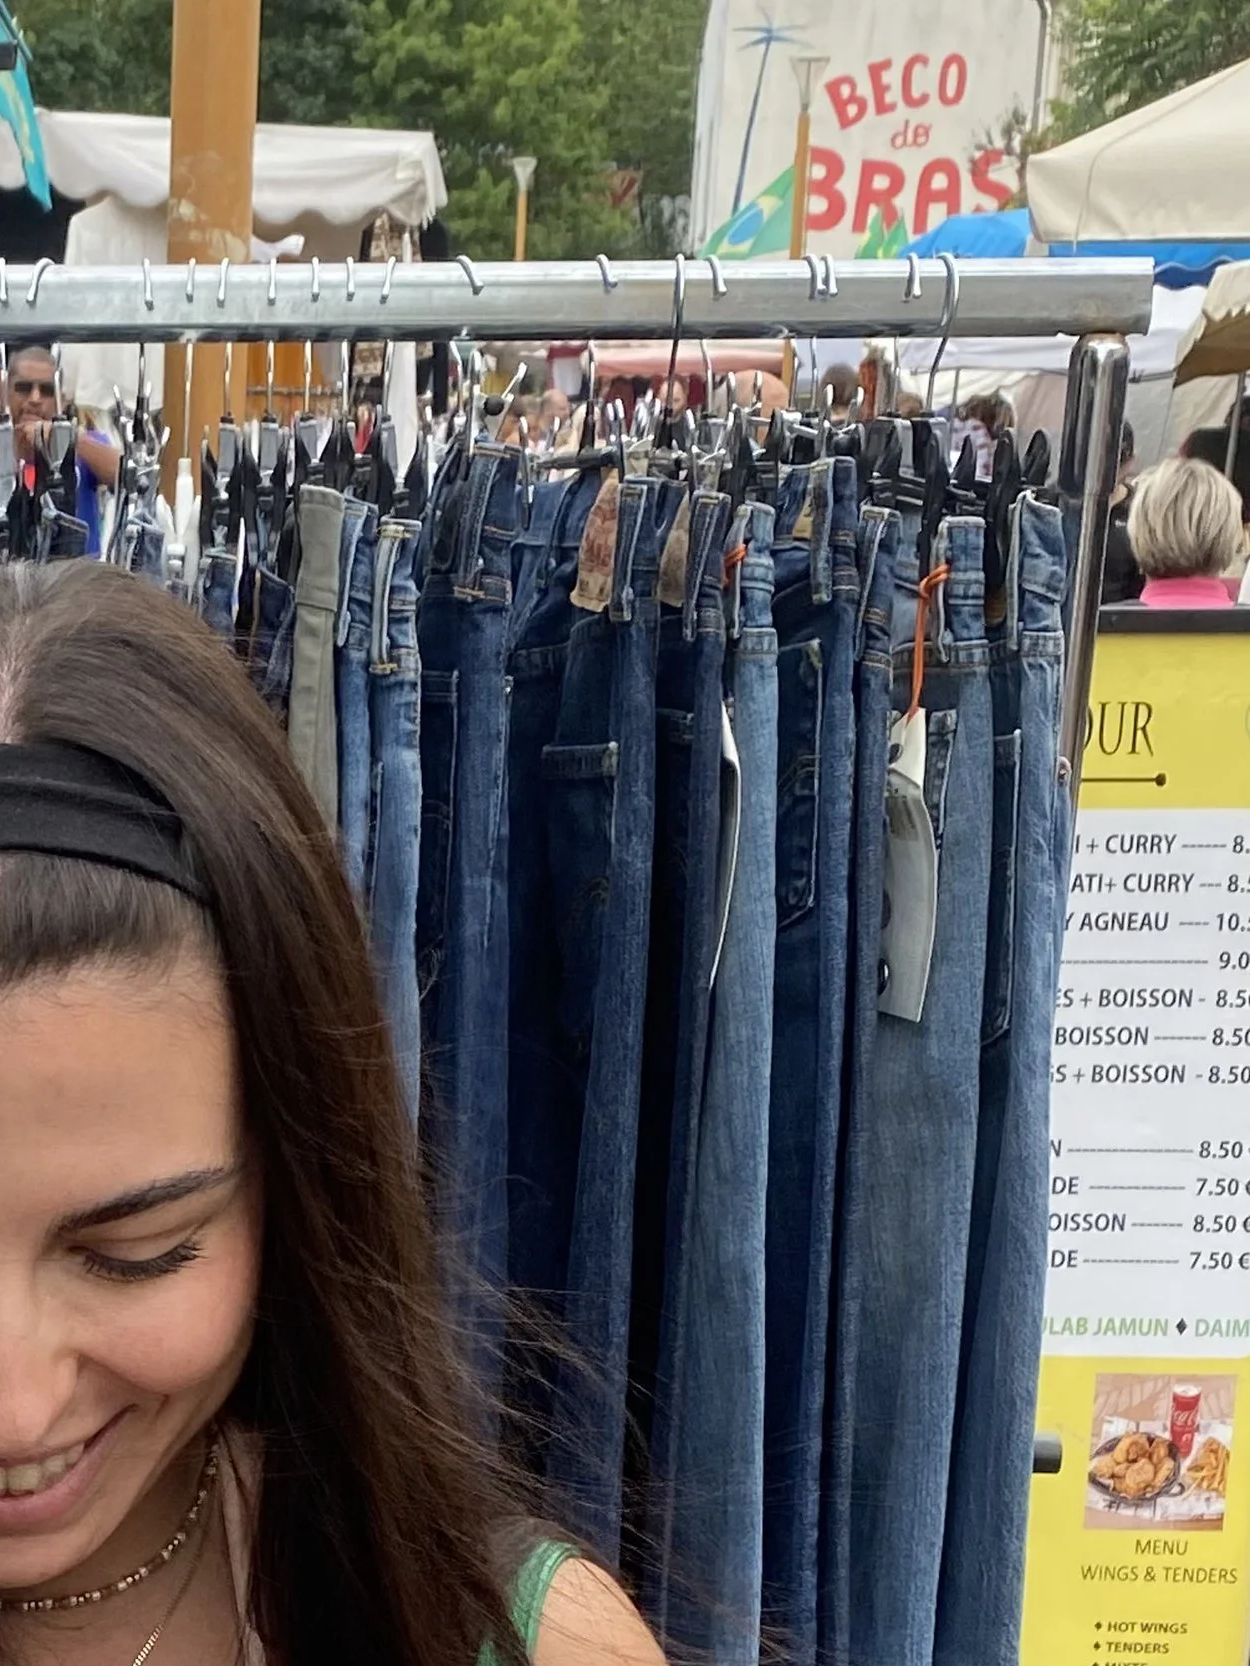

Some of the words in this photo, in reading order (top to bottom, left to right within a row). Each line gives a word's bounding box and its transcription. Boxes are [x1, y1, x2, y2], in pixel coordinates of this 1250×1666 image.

[823, 52, 968, 131] BECO
[890, 118, 933, 150] do
[1086, 838, 1099, 854] +
[1105, 834, 1178, 854] CURRY
[1123, 872, 1195, 894] CURRY
[1079, 911, 1170, 932] AGNEAU
[1080, 991, 1093, 1009] +
[1098, 987, 1194, 1009] BOISSON
[1054, 1026, 1149, 1046] BOISSON
[1072, 1067, 1085, 1084] +
[1091, 1064, 1186, 1084] BOISSON
[1208, 1065, 1250, 1085] 8.50
[1198, 1140, 1244, 1159] 8.50
[1051, 1175, 1080, 1195] DE
[1195, 1177, 1240, 1196] 7.50
[1048, 1212, 1127, 1232] OISSON
[1192, 1214, 1237, 1233] 8.50
[1050, 1249, 1079, 1269] DE
[1189, 1251, 1234, 1270] 7.50
[1238, 1251, 1250, 1270] €
[1092, 1316, 1169, 1337] JAMUN
[1134, 1538, 1189, 1556] MENU
[1080, 1563, 1139, 1583] WINGS
[1143, 1565, 1157, 1583] &
[1162, 1566, 1239, 1585] TENDERS
[1106, 1621, 1138, 1633] HOT
[1139, 1621, 1189, 1635] WINGS
[1105, 1641, 1171, 1655] TENDERS
